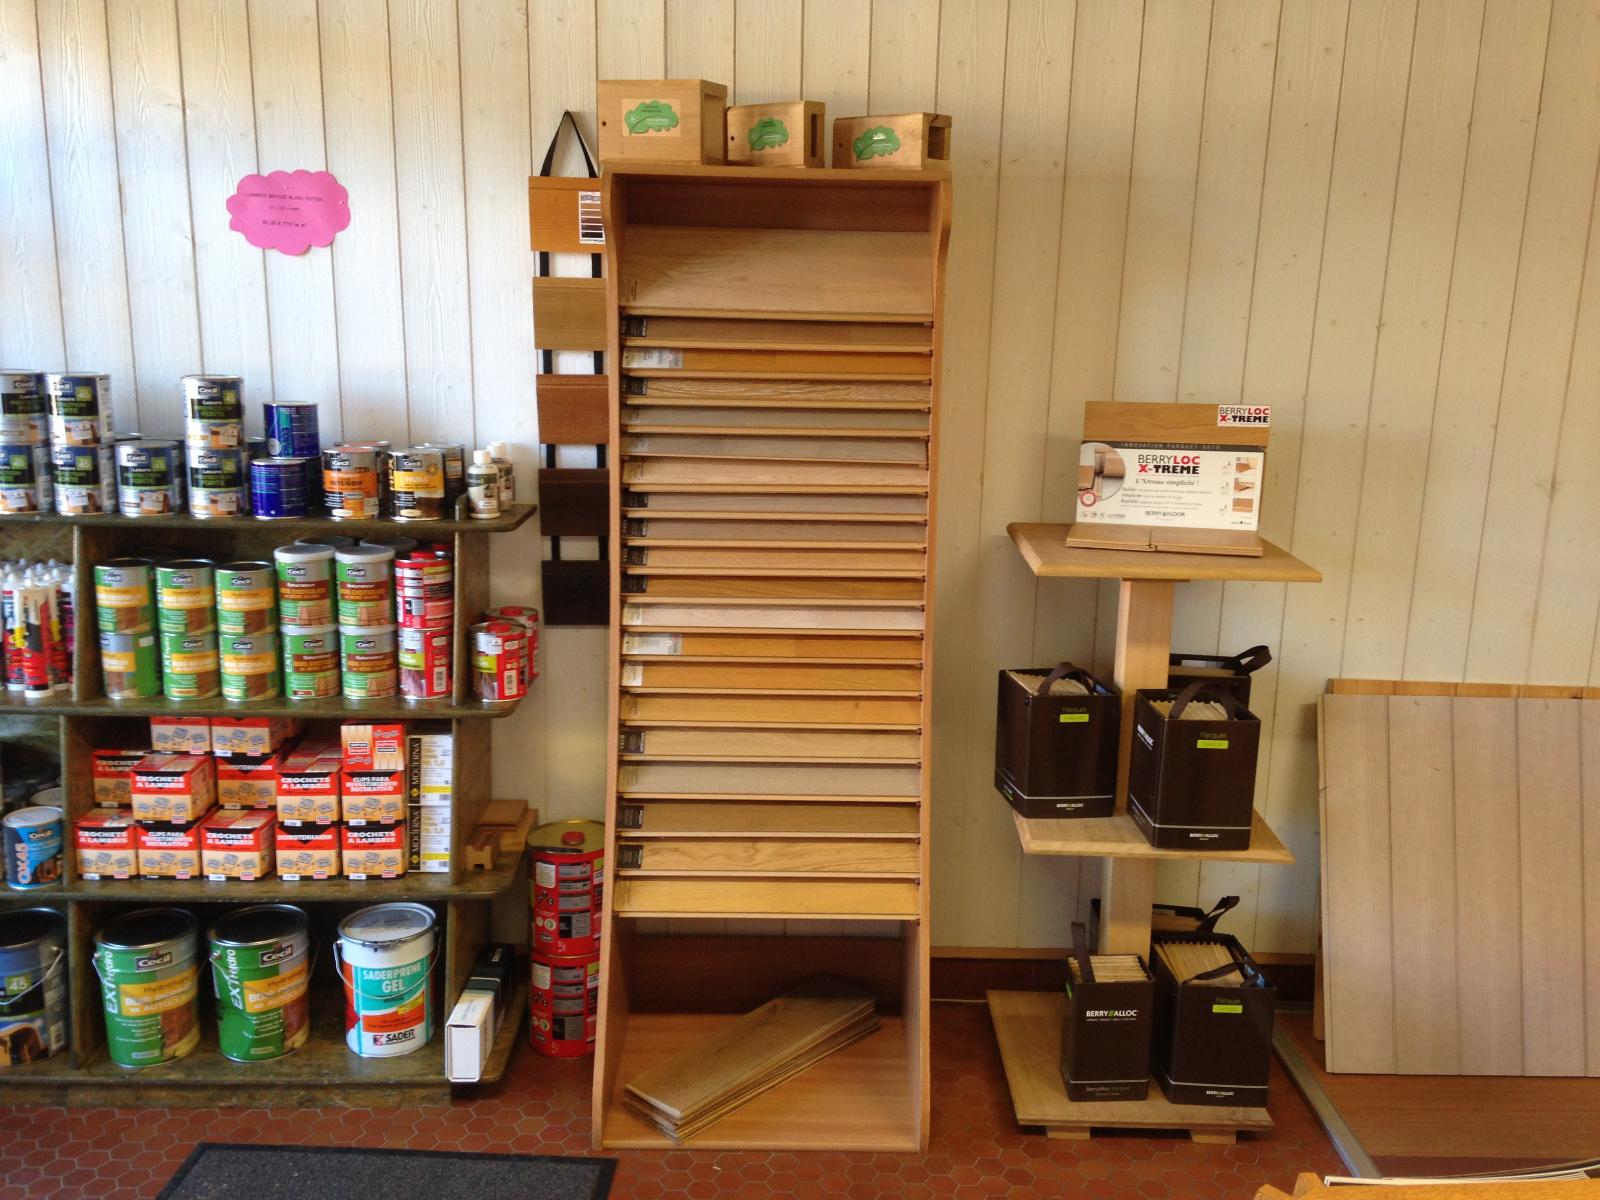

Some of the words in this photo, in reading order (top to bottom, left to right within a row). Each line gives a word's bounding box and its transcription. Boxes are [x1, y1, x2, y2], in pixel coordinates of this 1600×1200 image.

[1219, 406, 1270, 416] BERRYLOC
[1219, 415, 1270, 423] X-TREME
[1138, 454, 1201, 465] BERRYLOC
[1138, 464, 1200, 475] X-TREME
[138, 953, 172, 967] Cecil
[262, 946, 293, 962] Cecil
[362, 962, 422, 980] SADERPRENE
[382, 979, 406, 993] GEL
[385, 1028, 415, 1042] SADER
